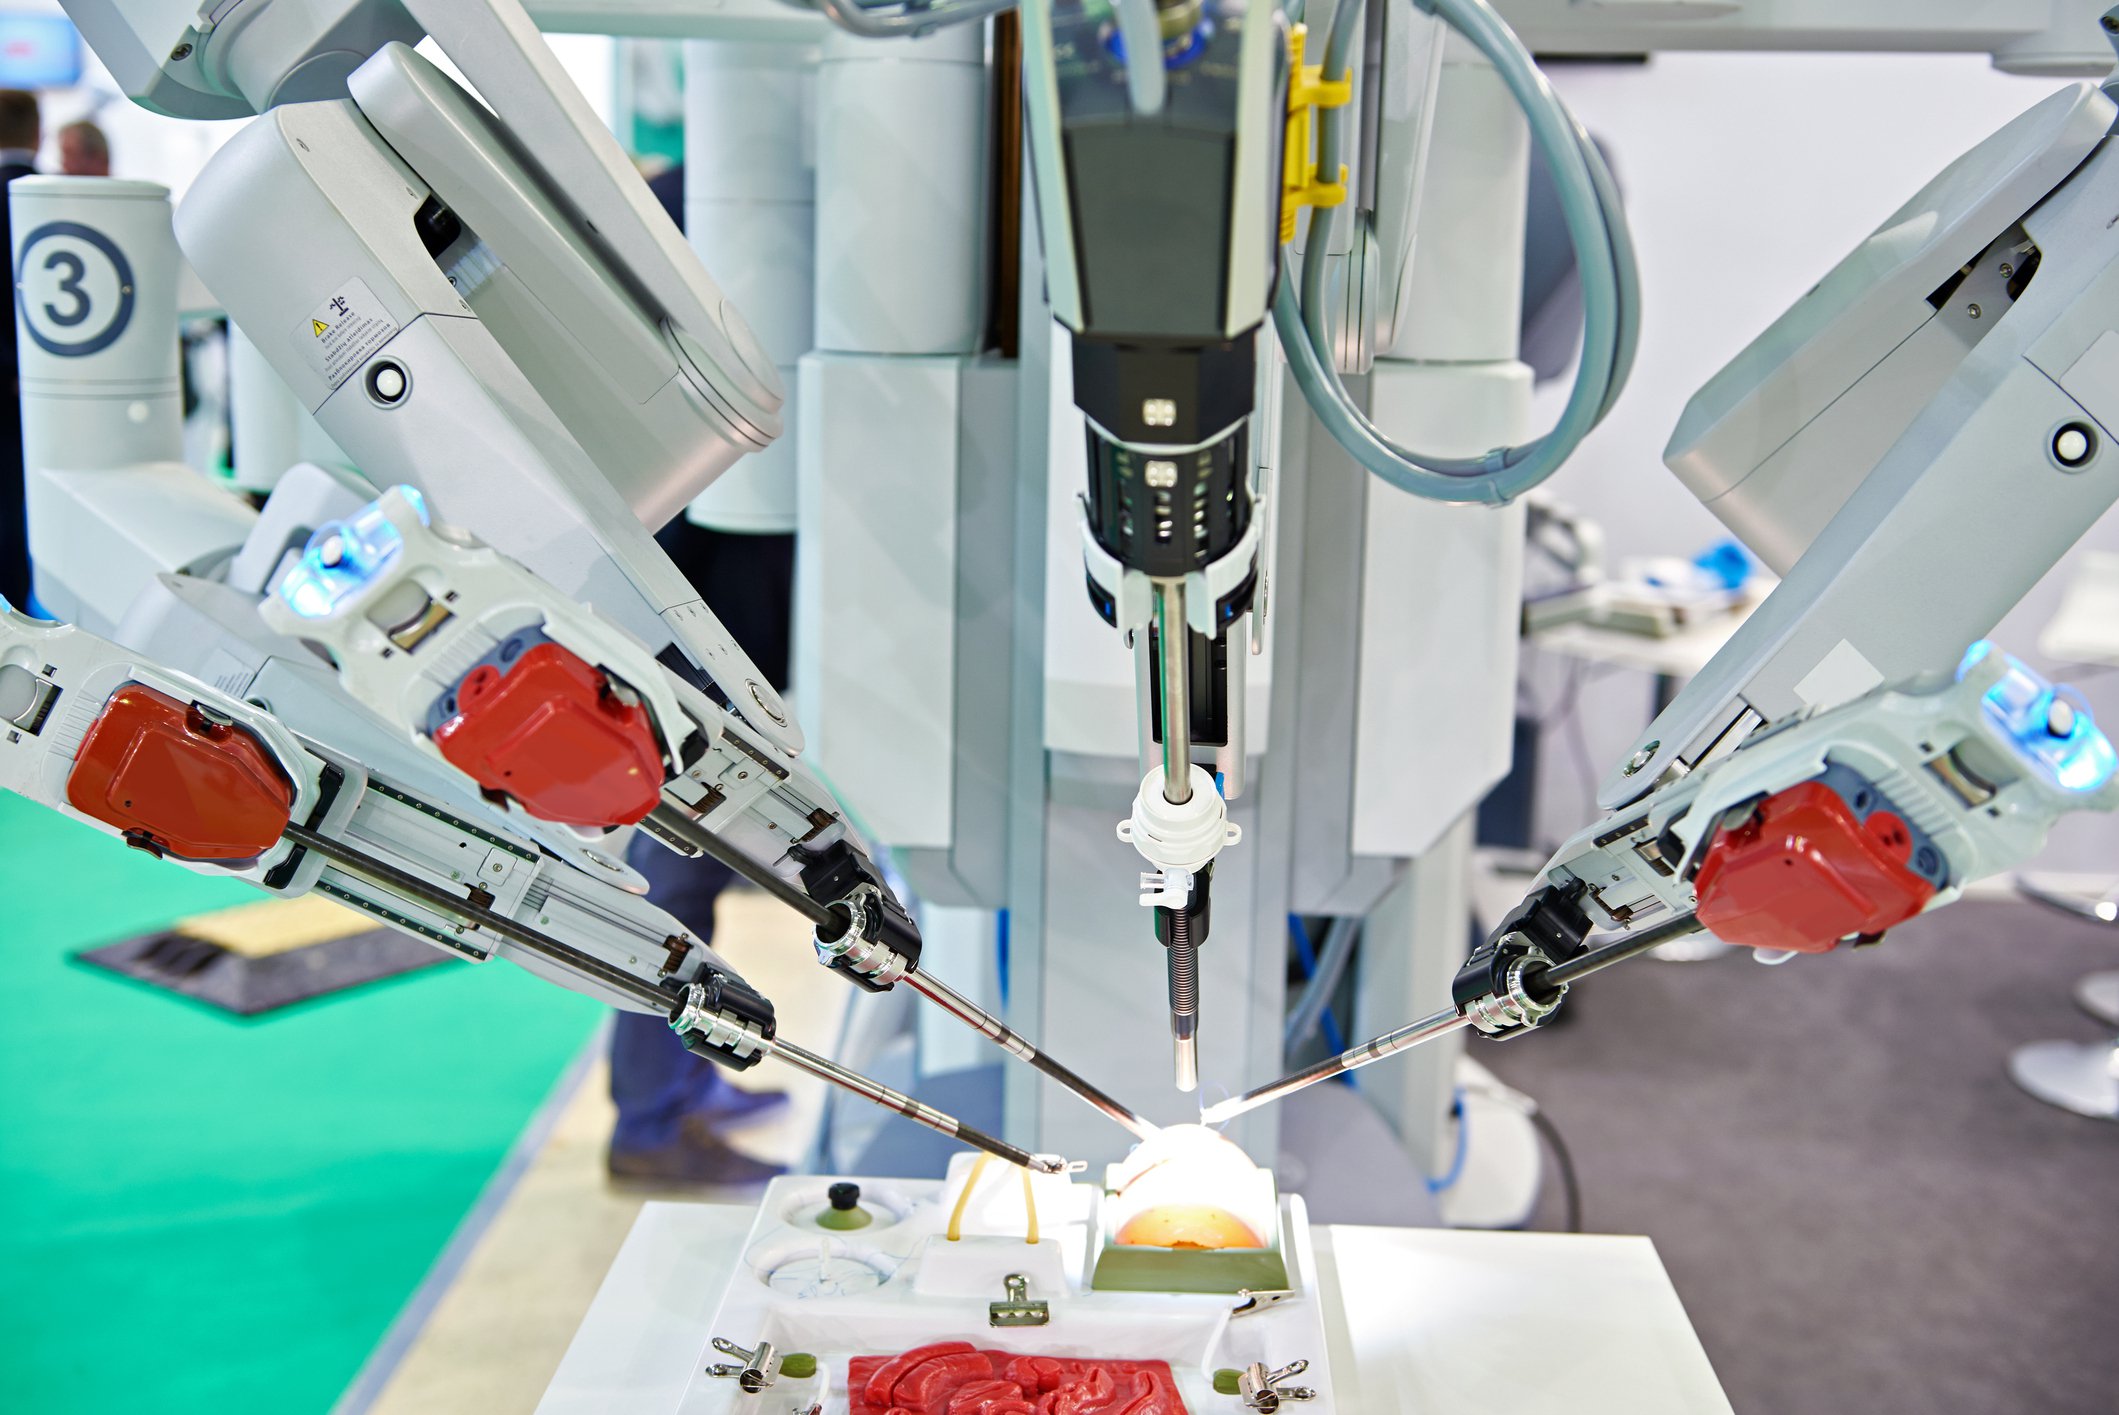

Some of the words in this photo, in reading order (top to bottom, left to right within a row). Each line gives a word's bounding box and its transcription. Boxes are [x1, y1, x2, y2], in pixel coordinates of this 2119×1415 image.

[43, 249, 91, 327] 3
[321, 329, 336, 344] Brake
[335, 311, 355, 330] Release
